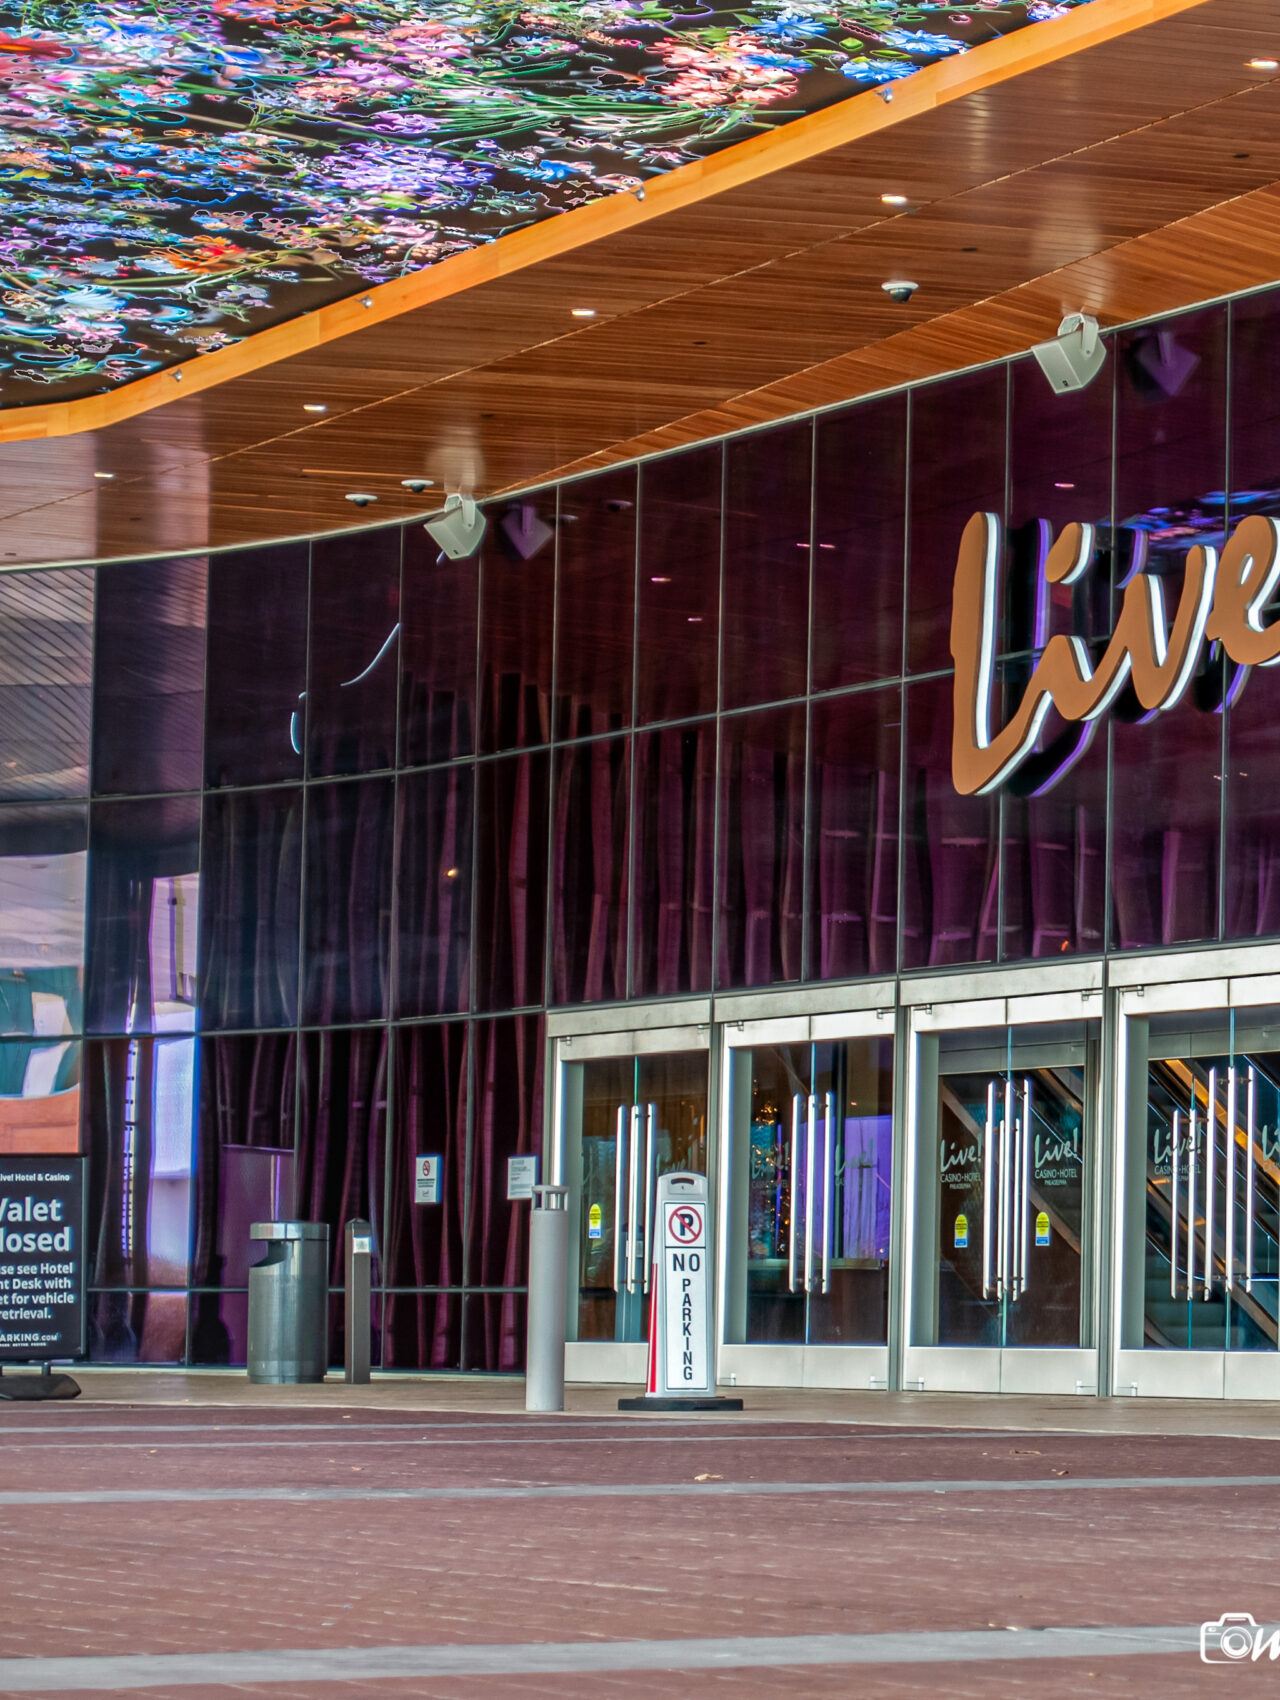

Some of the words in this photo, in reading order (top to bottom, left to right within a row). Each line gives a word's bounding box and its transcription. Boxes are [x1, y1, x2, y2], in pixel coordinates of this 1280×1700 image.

[940, 1133, 982, 1173] Live!
[1034, 1127, 1078, 1168] Live!
[15, 1173, 36, 1182] Hotel
[45, 1173, 70, 1181] Casino
[17, 1264, 37, 1275] see
[40, 1262, 73, 1274] Hotel
[672, 1253, 700, 1272] NO
[12, 1277, 41, 1290] Desk
[44, 1276, 71, 1289] with
[11, 1292, 29, 1305] for
[32, 1291, 75, 1304] vehicle
[0, 1306, 51, 1319] etrieval.
[682, 1278, 693, 1380] PARKING
